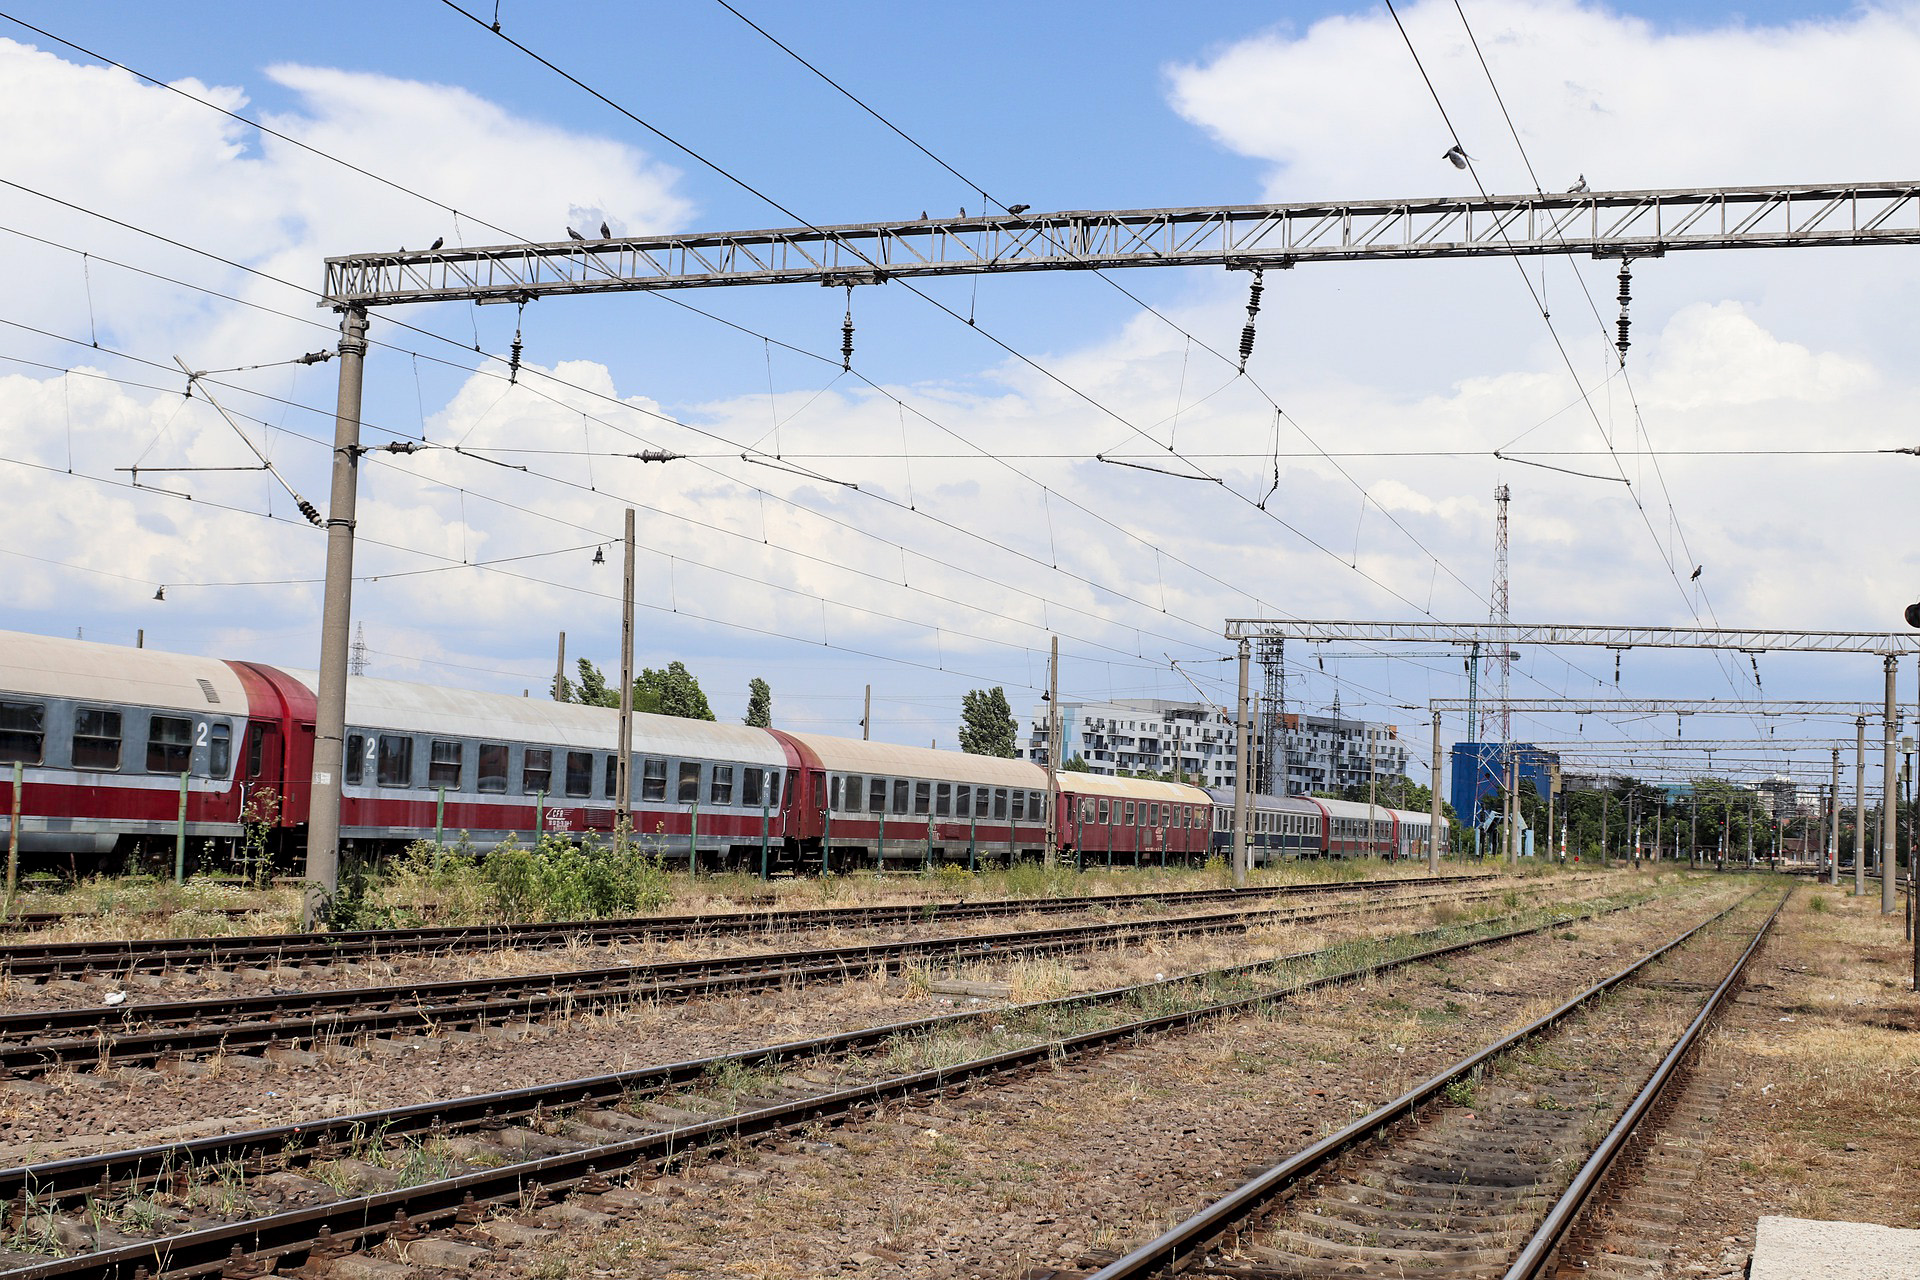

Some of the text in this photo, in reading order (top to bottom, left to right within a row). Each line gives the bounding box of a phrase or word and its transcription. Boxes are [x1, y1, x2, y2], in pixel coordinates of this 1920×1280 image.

[196, 722, 208, 747] 2
[365, 737, 376, 759] 2
[763, 771, 770, 788] 2
[839, 778, 845, 793] 2
[552, 809, 564, 818] CFR
